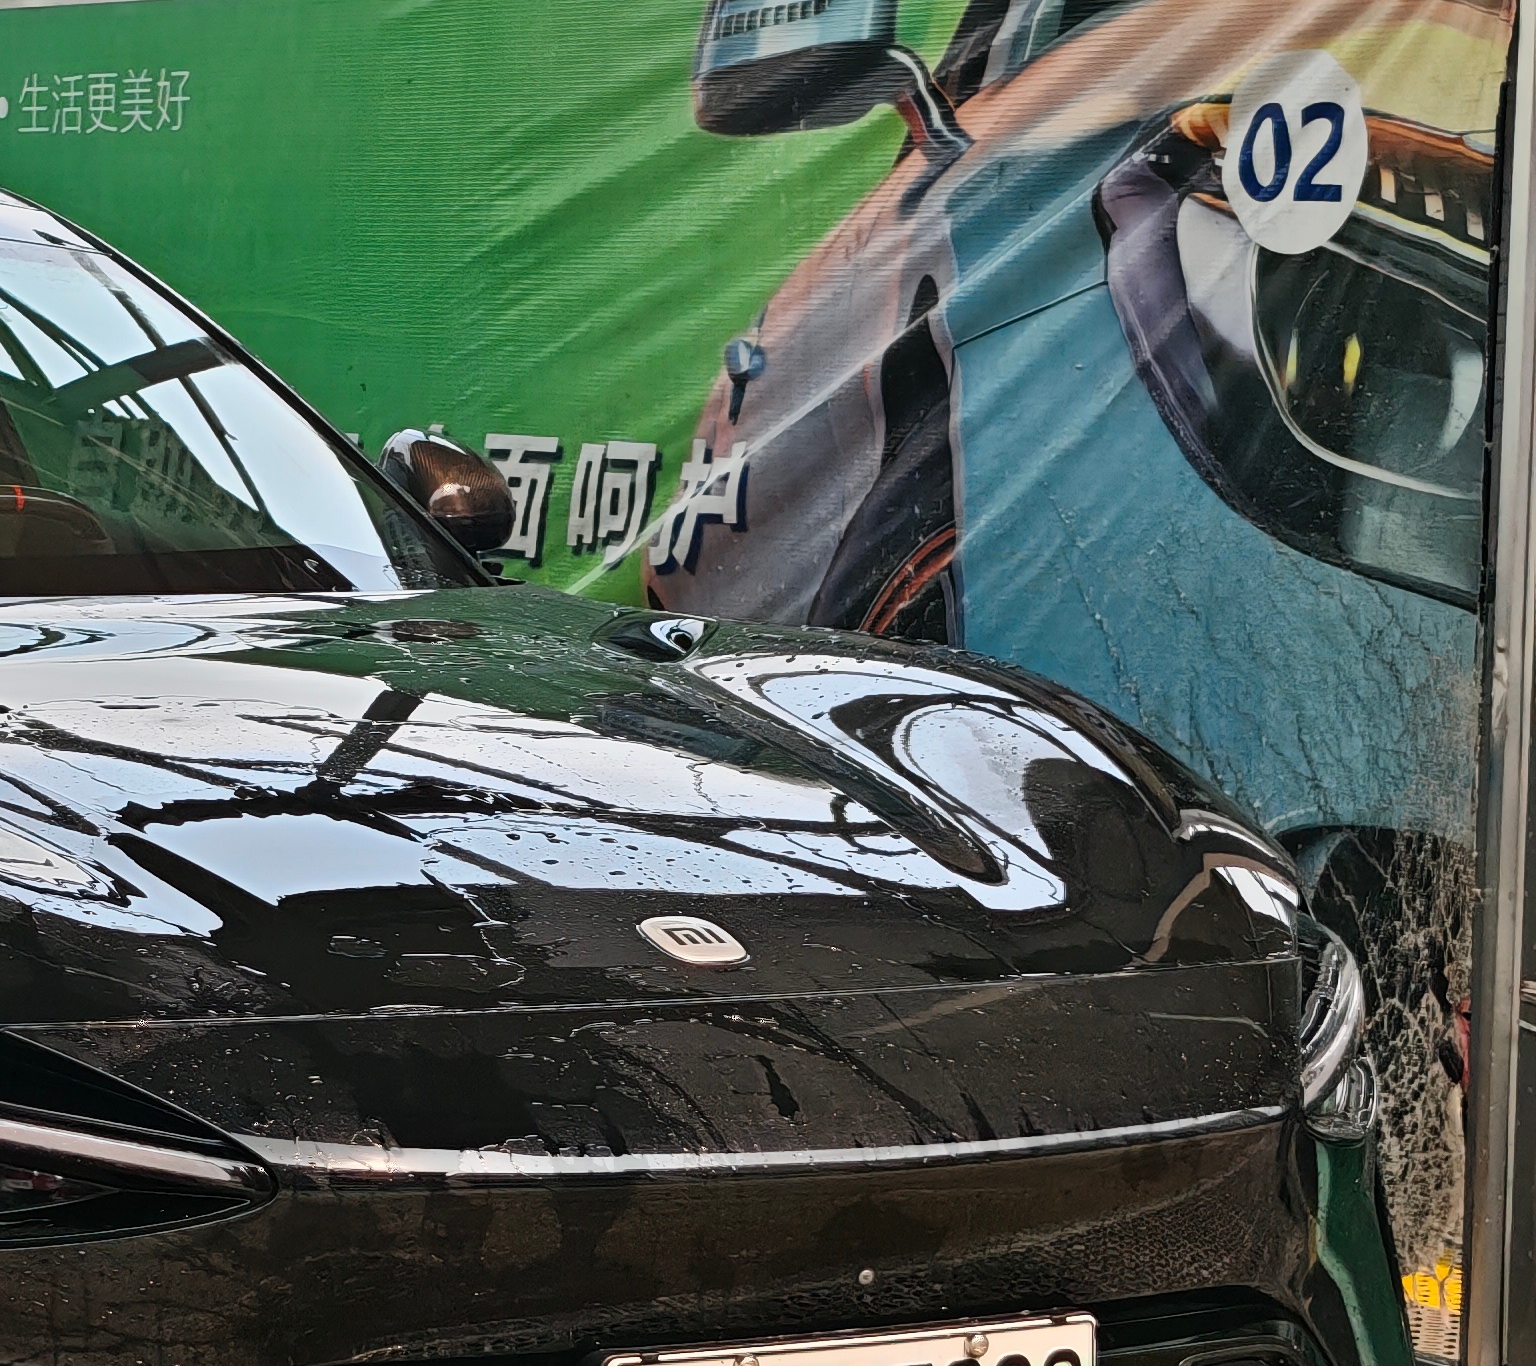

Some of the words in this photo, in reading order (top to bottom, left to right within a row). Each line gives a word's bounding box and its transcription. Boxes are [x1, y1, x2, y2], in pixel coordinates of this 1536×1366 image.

[1238, 102, 1346, 203] 02
[428, 424, 748, 567] 面呵护
